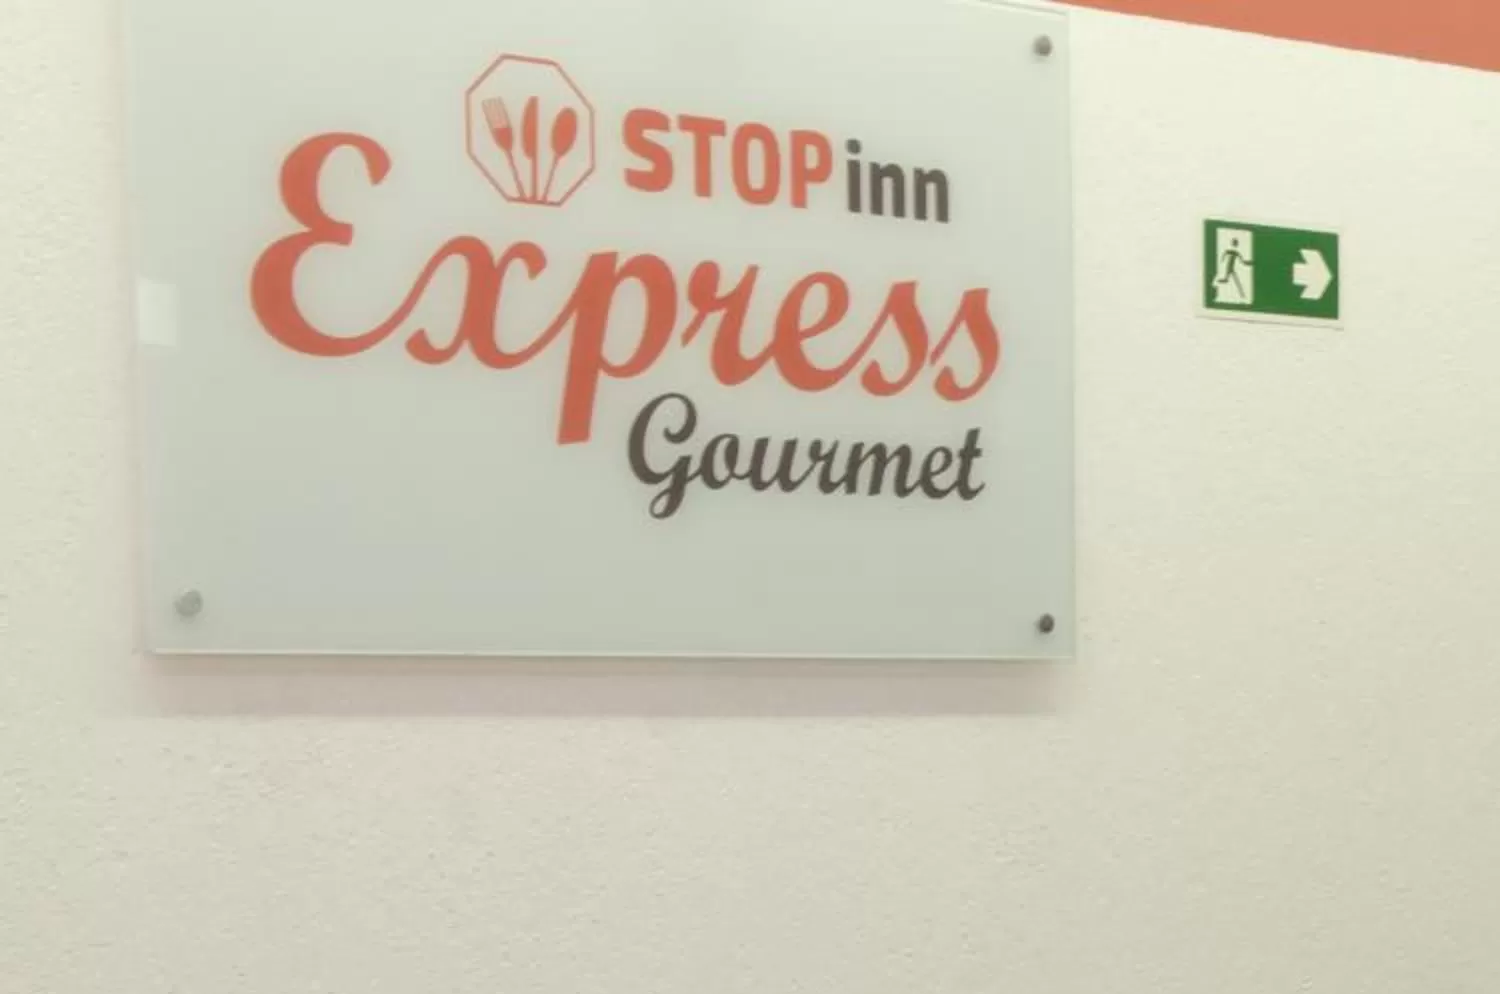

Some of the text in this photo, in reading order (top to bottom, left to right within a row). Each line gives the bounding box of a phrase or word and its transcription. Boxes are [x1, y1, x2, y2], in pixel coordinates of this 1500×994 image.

[621, 107, 950, 223] STOP inn
[249, 131, 1001, 445] Express
[627, 392, 986, 520] Gourmet
